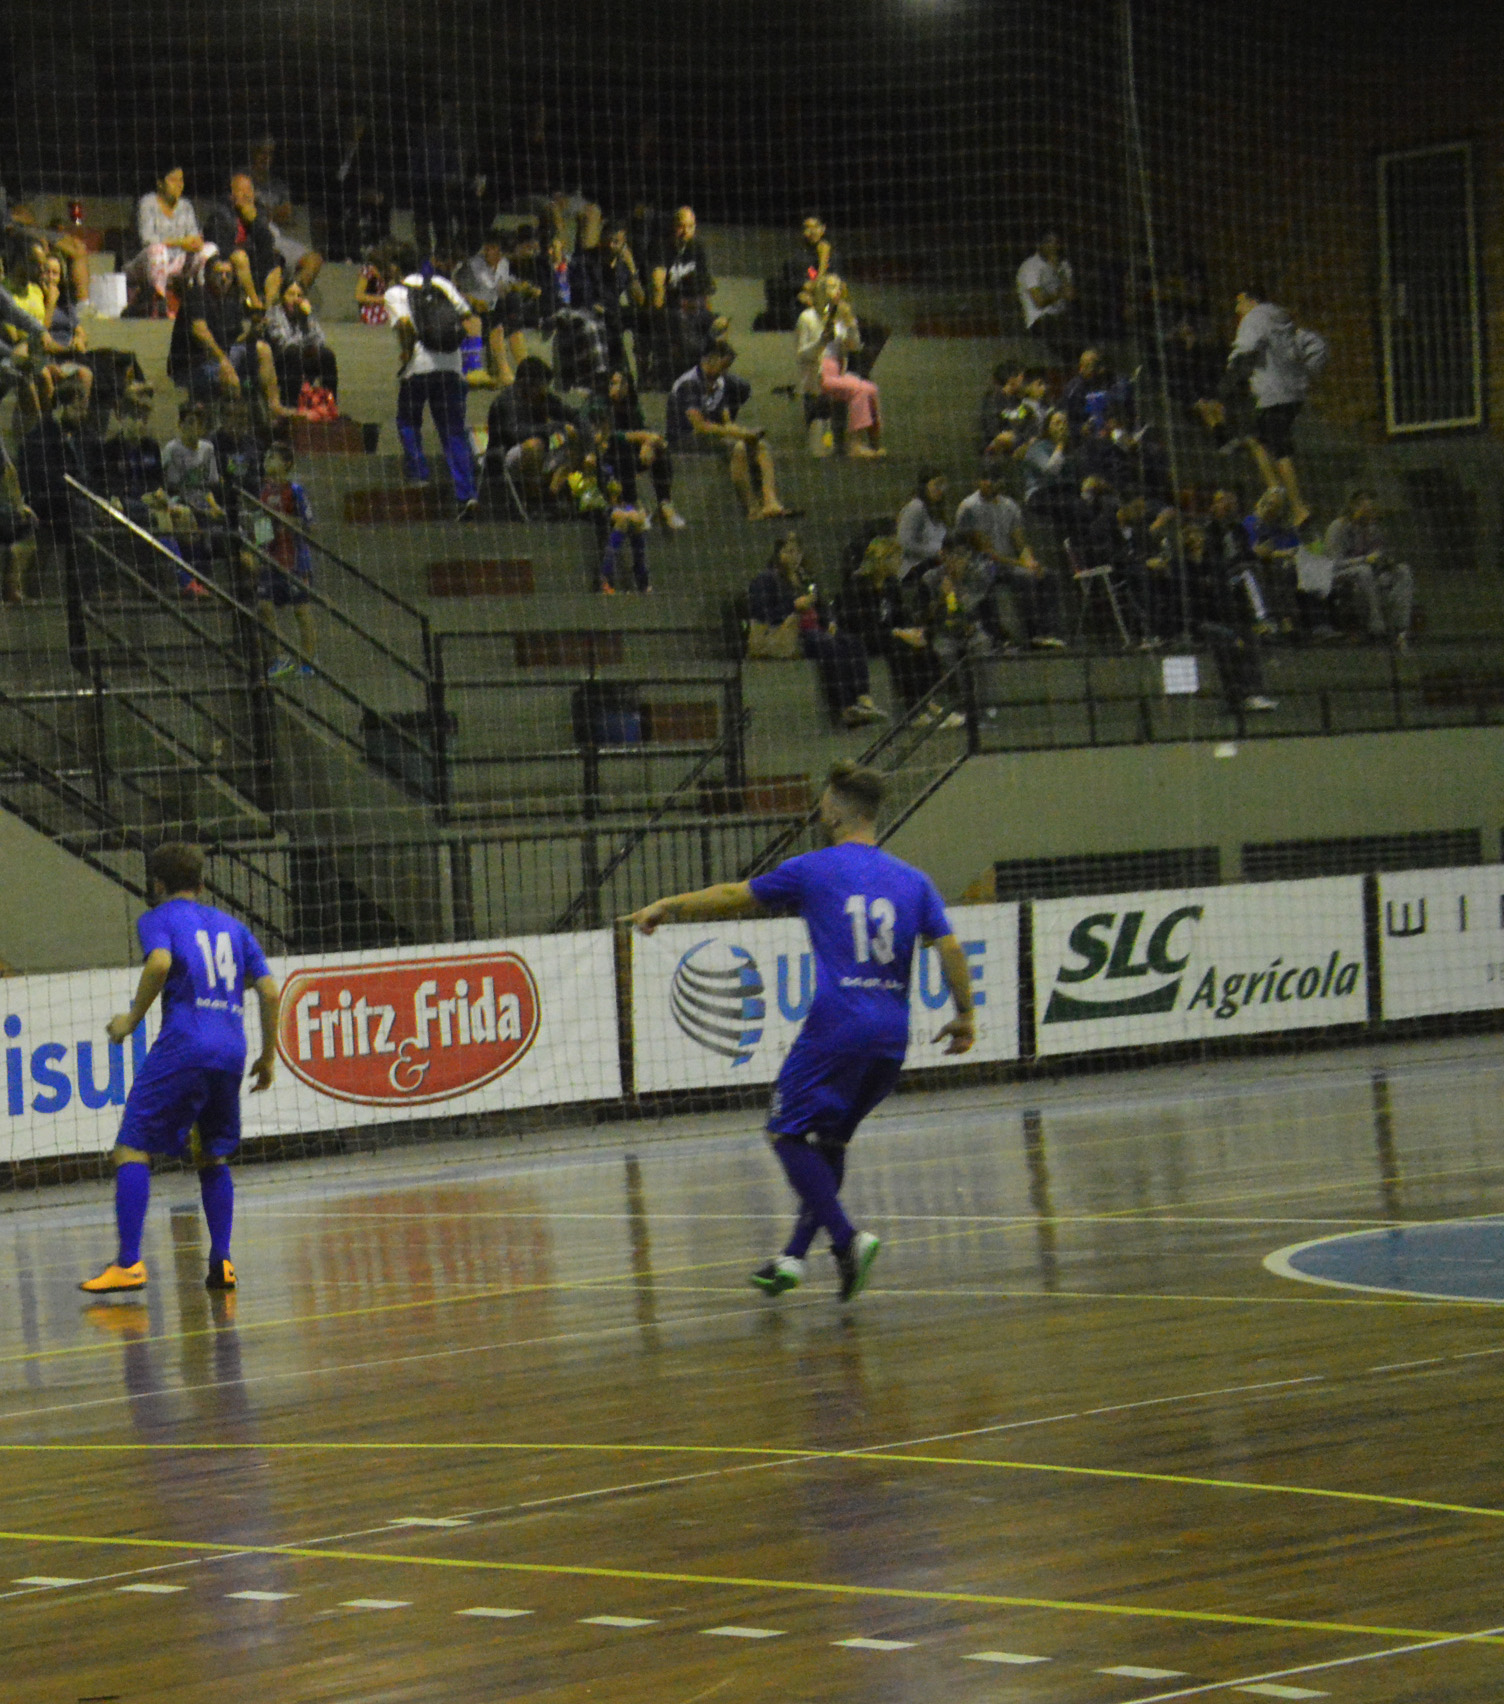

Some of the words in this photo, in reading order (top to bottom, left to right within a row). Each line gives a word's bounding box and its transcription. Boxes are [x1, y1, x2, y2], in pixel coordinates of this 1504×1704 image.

[195, 929, 237, 992] 14
[845, 894, 896, 965] 13
[1056, 904, 1205, 984] SLC
[296, 989, 397, 1062] Fritz
[413, 961, 523, 1050] Frida
[1187, 949, 1362, 1020] Agrícola
